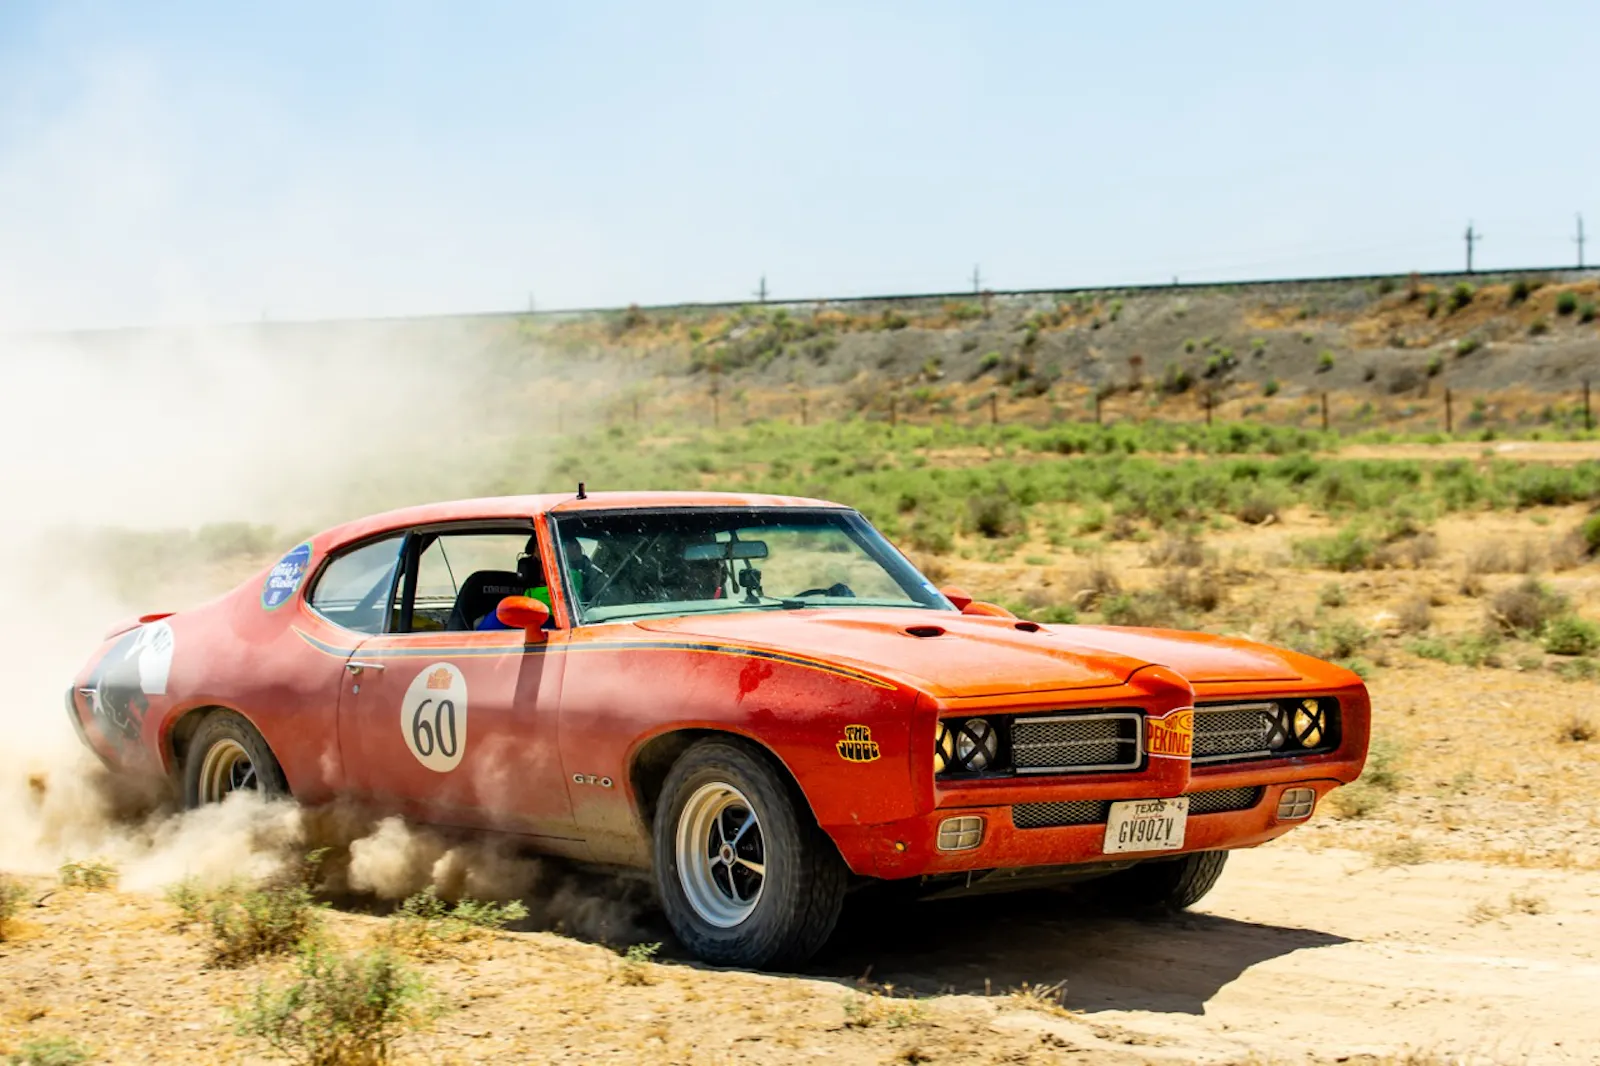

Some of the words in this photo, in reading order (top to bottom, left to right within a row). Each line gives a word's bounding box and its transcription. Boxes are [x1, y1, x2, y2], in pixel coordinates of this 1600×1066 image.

[412, 698, 457, 757] 60
[845, 725, 870, 741] THE
[1147, 721, 1190, 753] PEKING
[836, 740, 880, 763] JUDGE
[572, 773, 613, 788] GTO
[1135, 801, 1167, 814] TEXAS
